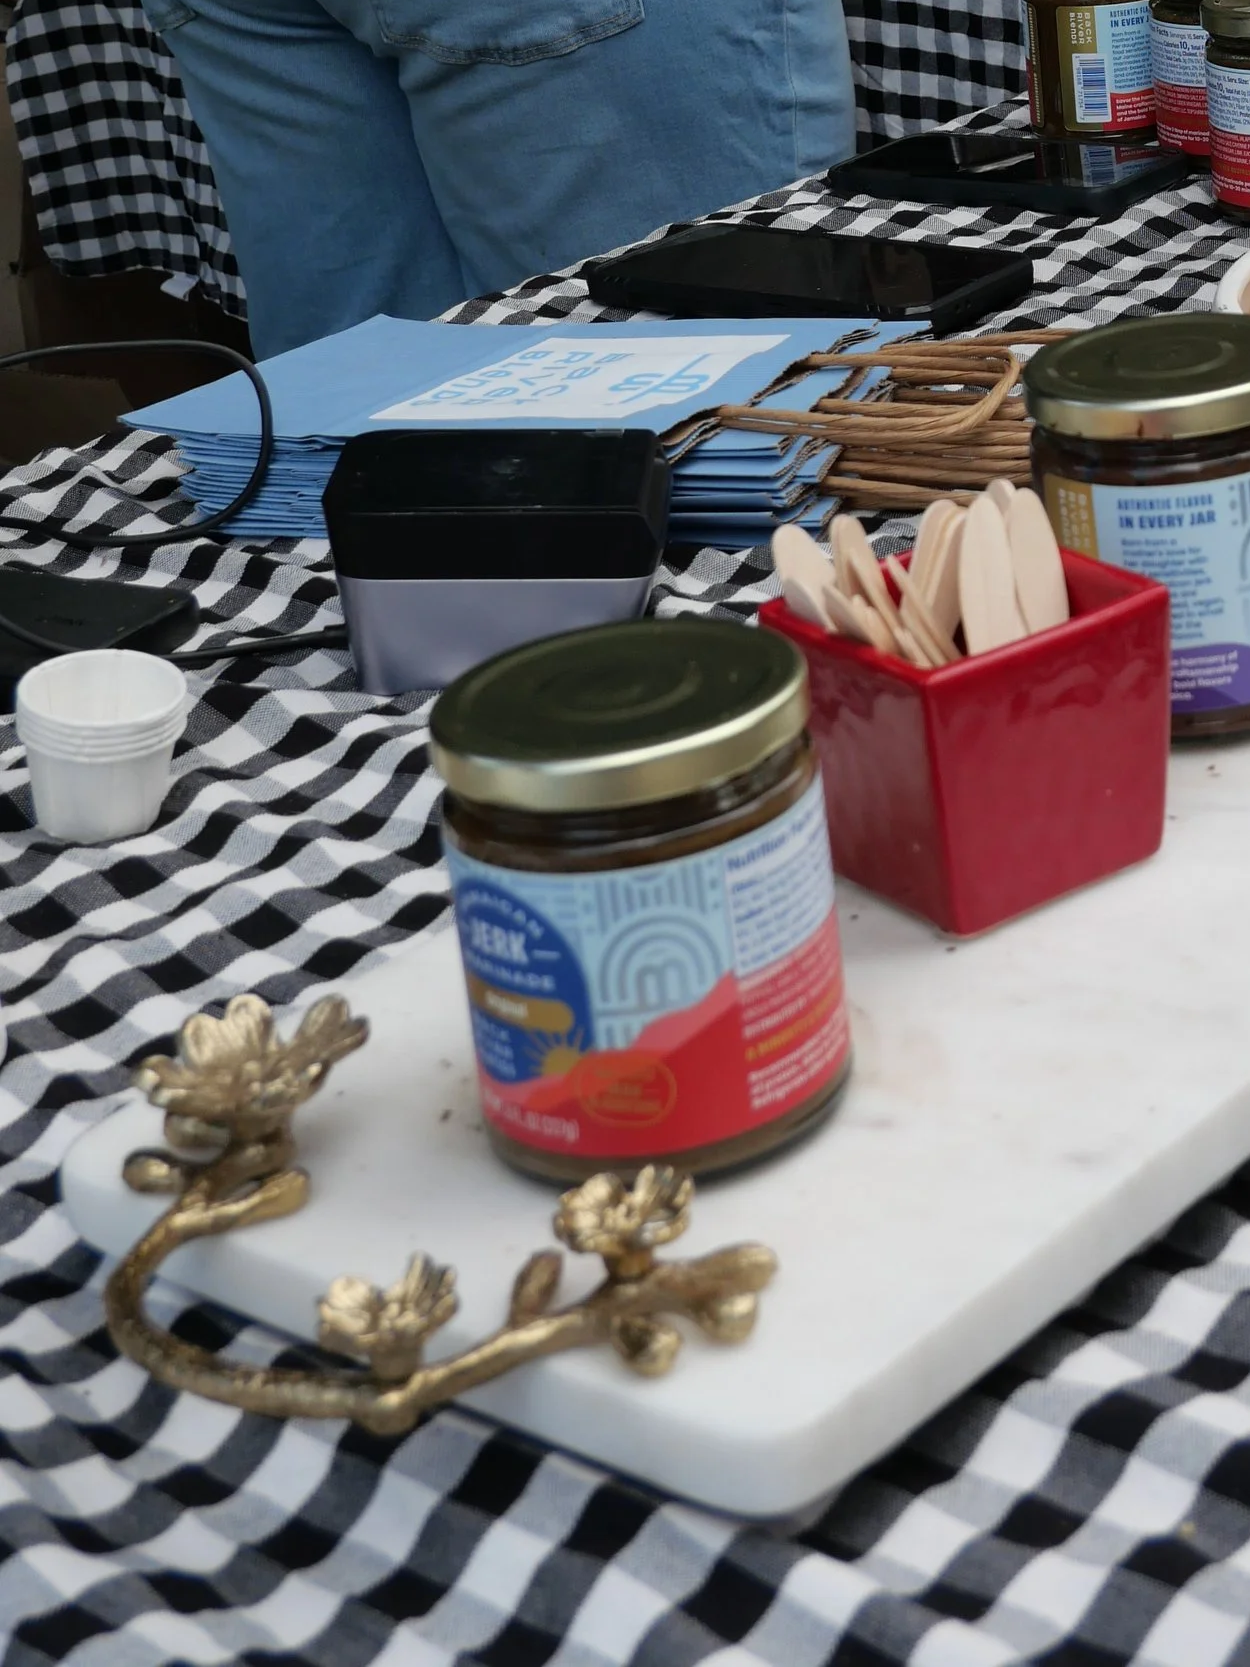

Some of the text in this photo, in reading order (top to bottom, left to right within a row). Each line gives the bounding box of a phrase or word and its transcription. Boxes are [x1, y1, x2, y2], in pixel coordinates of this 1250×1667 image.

[1110, 7, 1140, 18] AUTHENTIC
[1110, 16, 1144, 28] IN EVERY
[1180, 41, 1190, 50] 10,
[1117, 494, 1214, 511] AUTHENTIC FLAVOR
[1119, 510, 1217, 530] IN EVERY JAR
[468, 917, 529, 966] JERK
